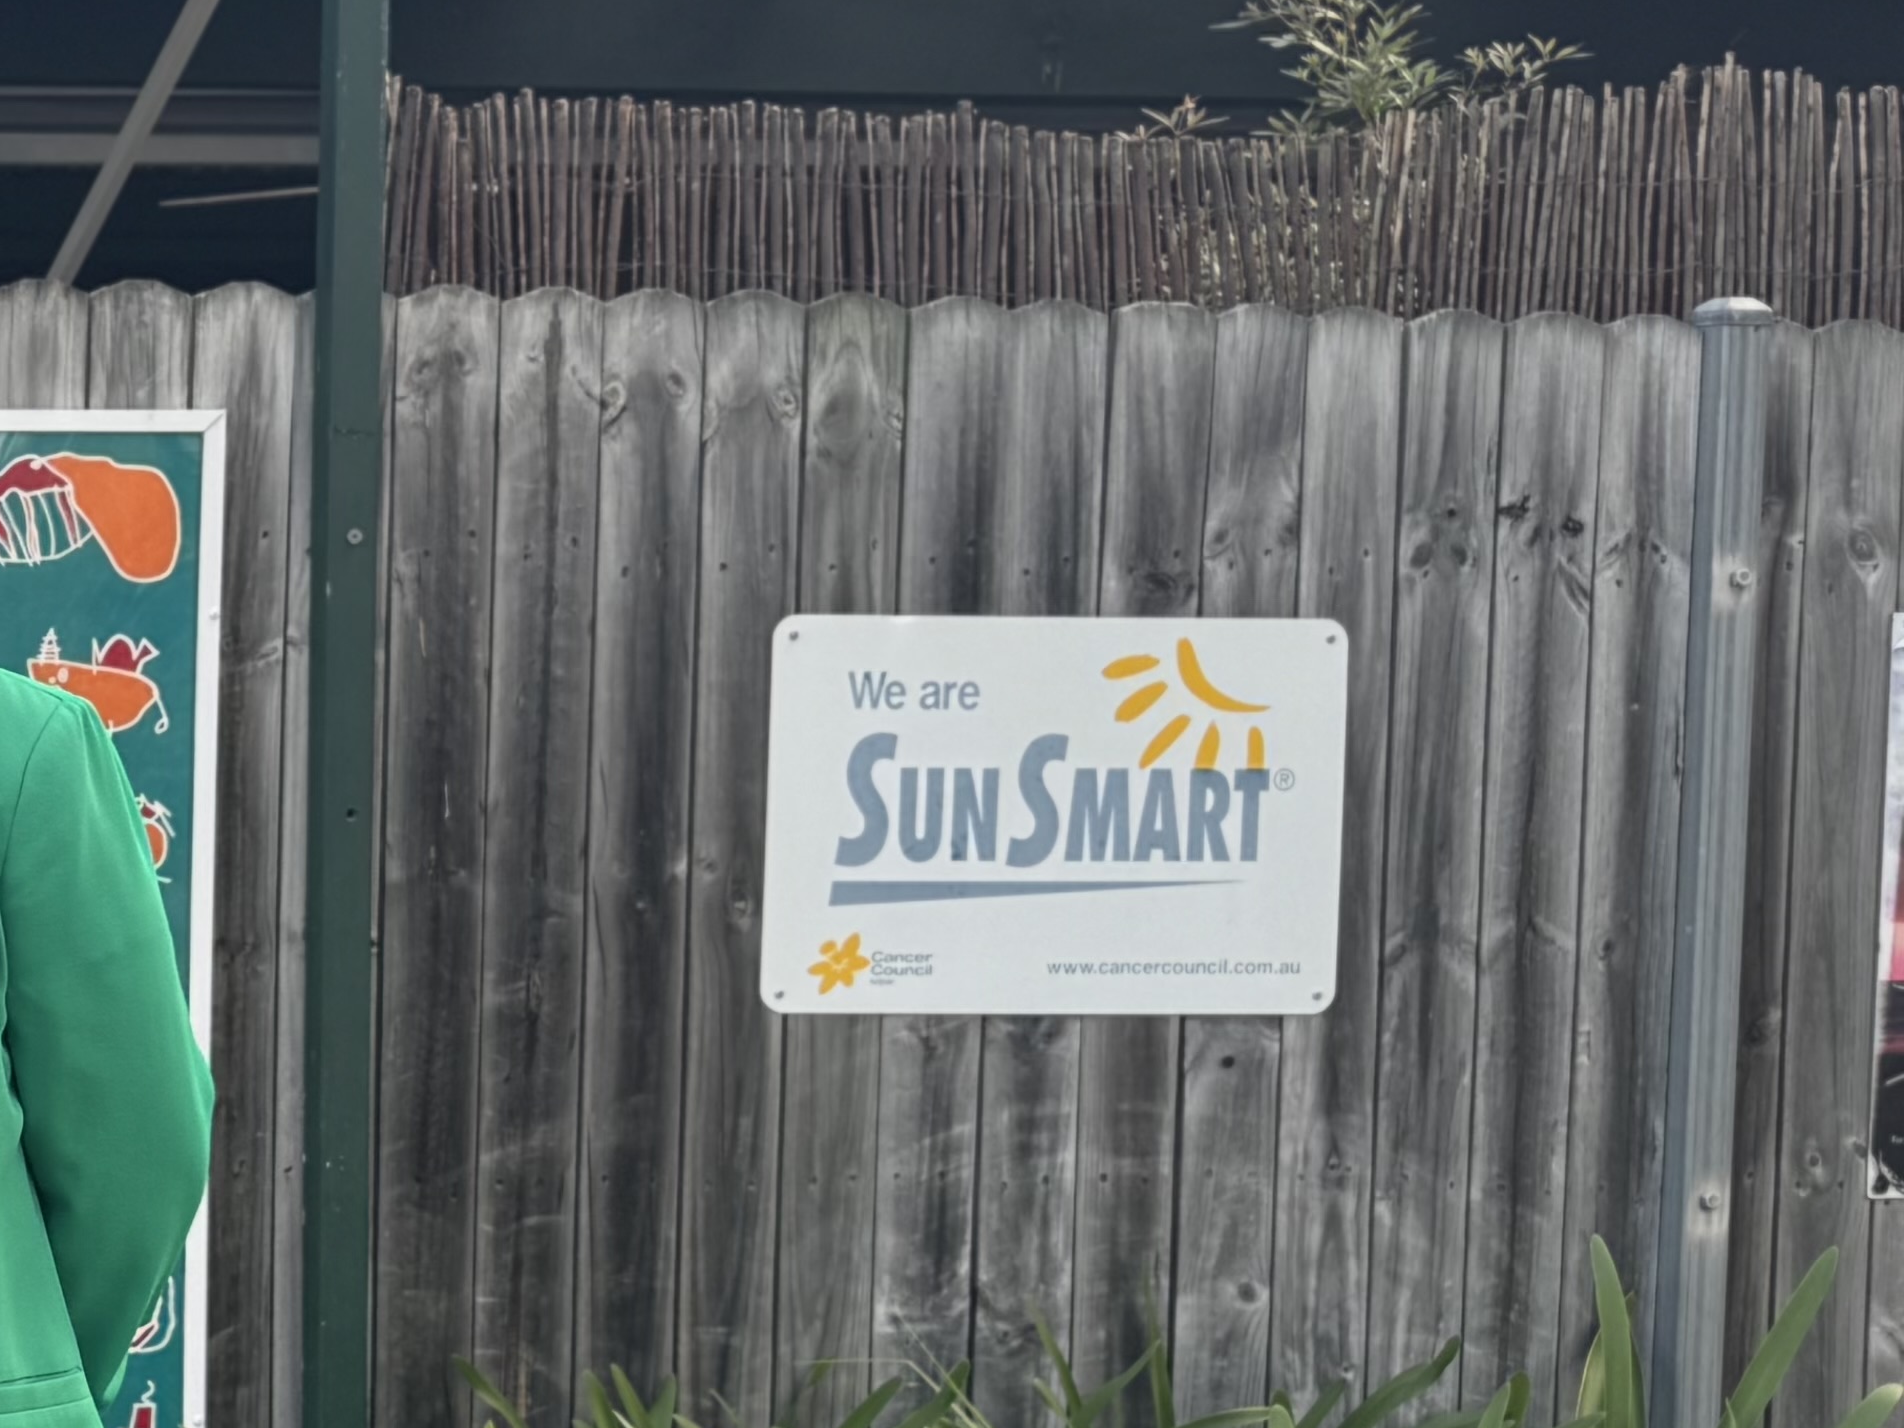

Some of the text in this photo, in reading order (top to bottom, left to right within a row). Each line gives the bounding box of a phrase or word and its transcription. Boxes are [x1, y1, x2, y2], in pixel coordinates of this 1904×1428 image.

[849, 671, 981, 711] We are
[871, 951, 933, 963] Cancer
[871, 964, 933, 976] Council
[1046, 957, 1302, 977] www.cancercouncil.com.au
